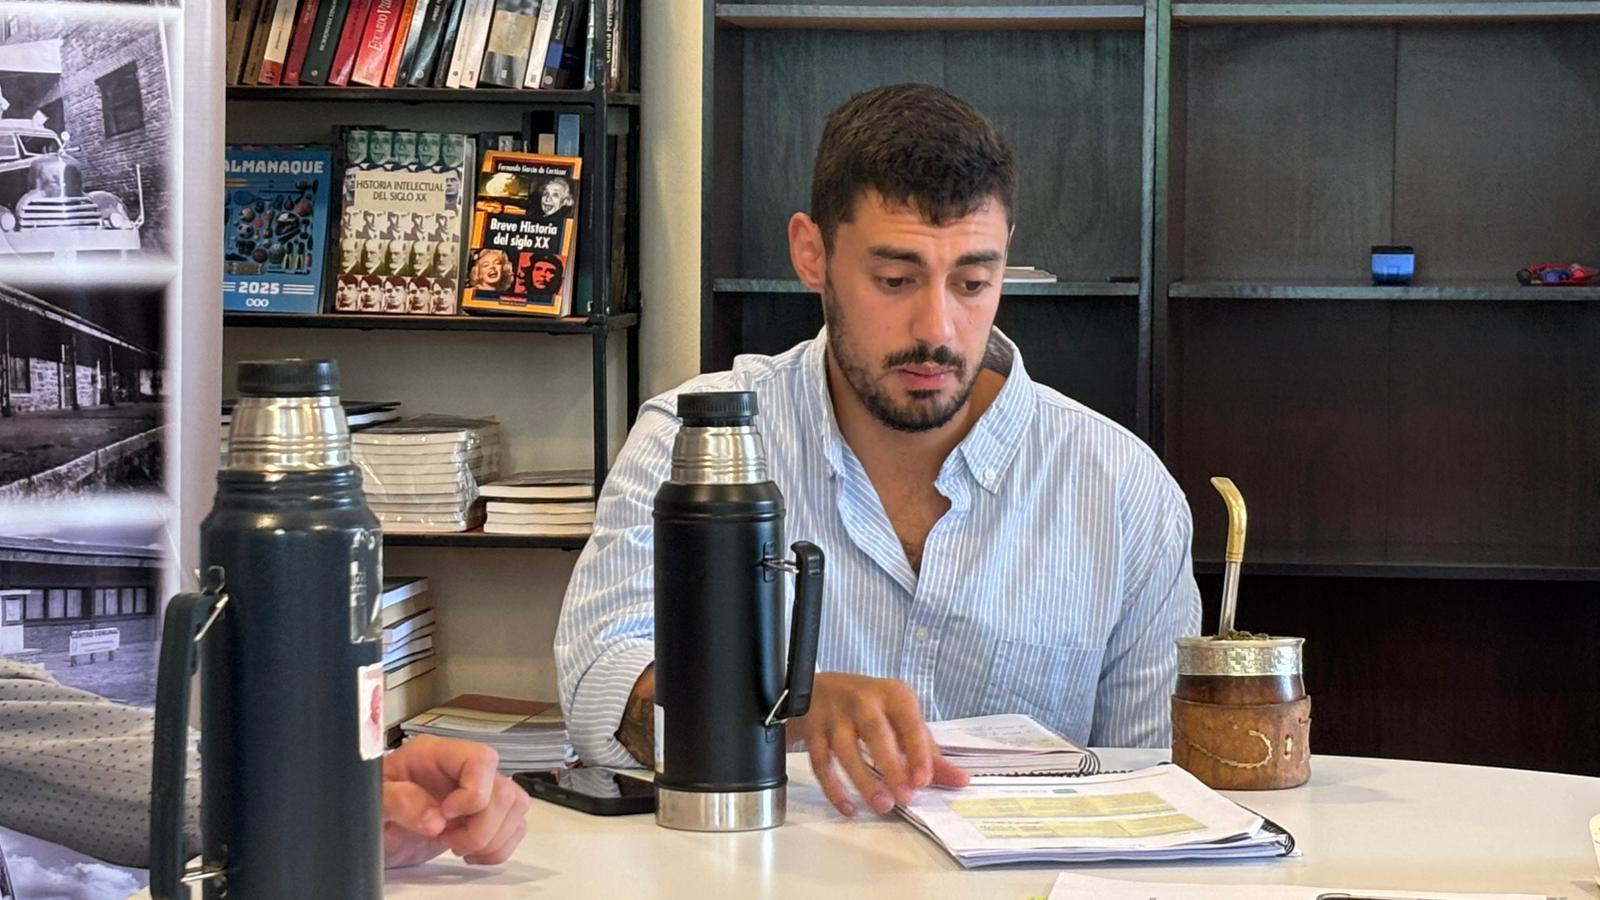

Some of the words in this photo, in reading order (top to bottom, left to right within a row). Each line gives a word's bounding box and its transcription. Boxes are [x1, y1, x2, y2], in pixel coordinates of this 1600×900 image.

[498, 163, 521, 172] Fernando
[357, 180, 392, 190] HISTORIA
[394, 181, 445, 192] INTELECTUAL
[373, 191, 387, 201] DEL
[390, 192, 414, 201] SIGLO
[415, 193, 427, 202] XX
[490, 218, 518, 232] Breve
[520, 220, 558, 235] Historia
[493, 232, 510, 246] del
[510, 234, 533, 250] siglo
[534, 236, 551, 249] XX
[238, 281, 280, 294] 2025
